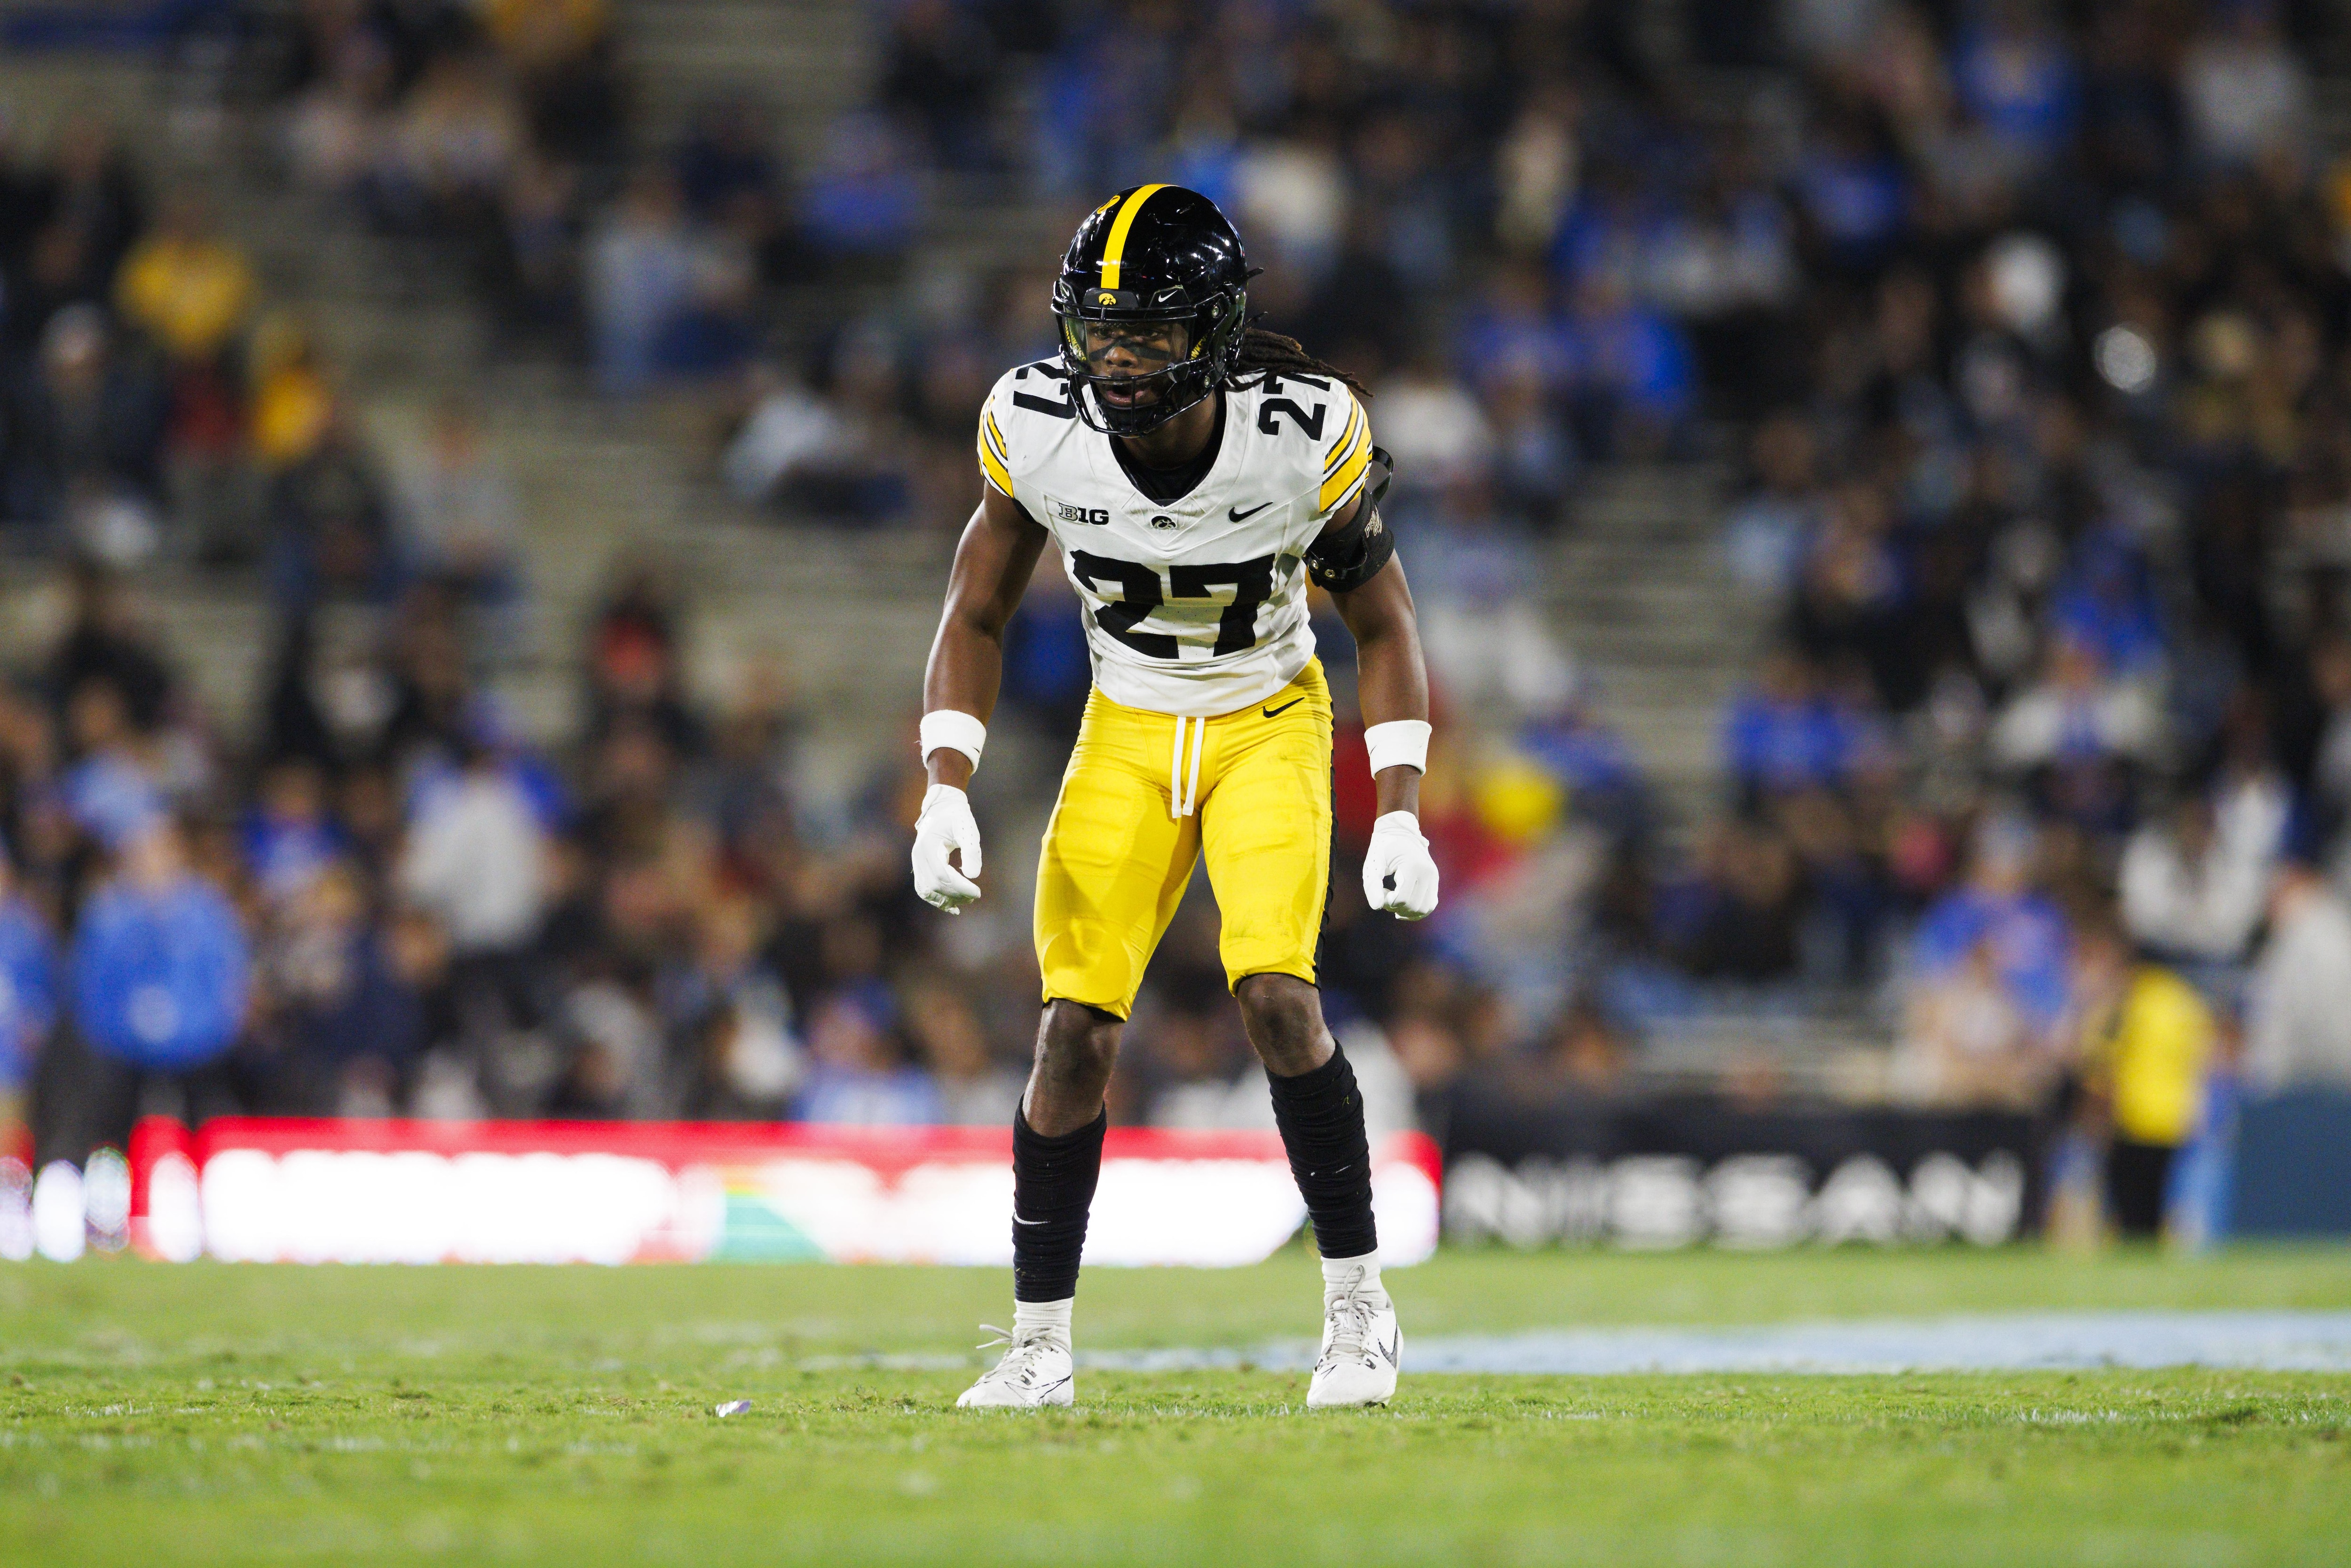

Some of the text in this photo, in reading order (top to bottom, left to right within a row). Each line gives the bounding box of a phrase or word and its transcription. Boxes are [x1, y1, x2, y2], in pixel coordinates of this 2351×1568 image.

[1013, 362, 1076, 419] 27
[1258, 373, 1331, 441] 27
[1070, 549, 1276, 659] 27
[1444, 1149, 2025, 1251] NISSAN
